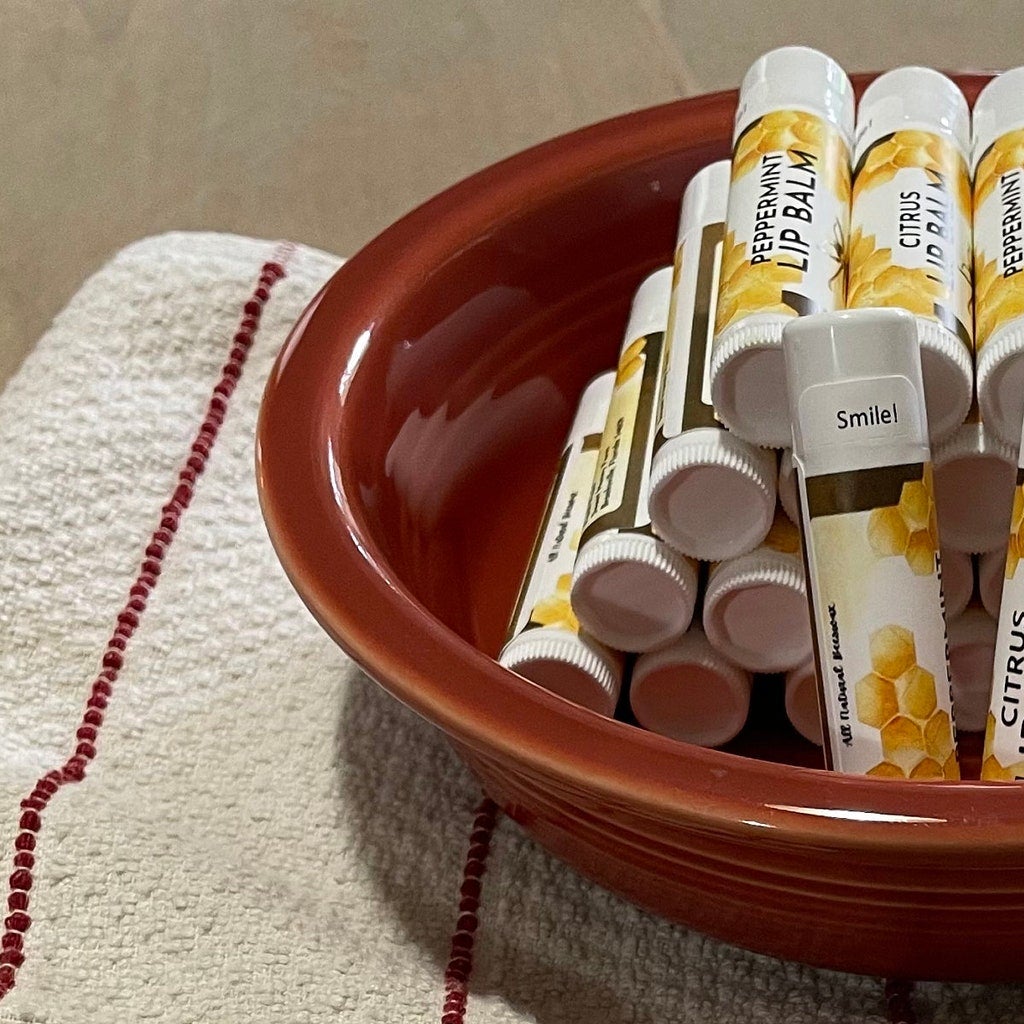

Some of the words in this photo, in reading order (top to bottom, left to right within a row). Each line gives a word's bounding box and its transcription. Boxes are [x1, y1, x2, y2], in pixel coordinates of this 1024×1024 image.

[751, 155, 782, 265] PEPPERMINT
[782, 149, 818, 224] BALM
[900, 191, 921, 248] CITRUS
[777, 229, 810, 272] LIP
[1001, 171, 1023, 278] PEPPERMINT
